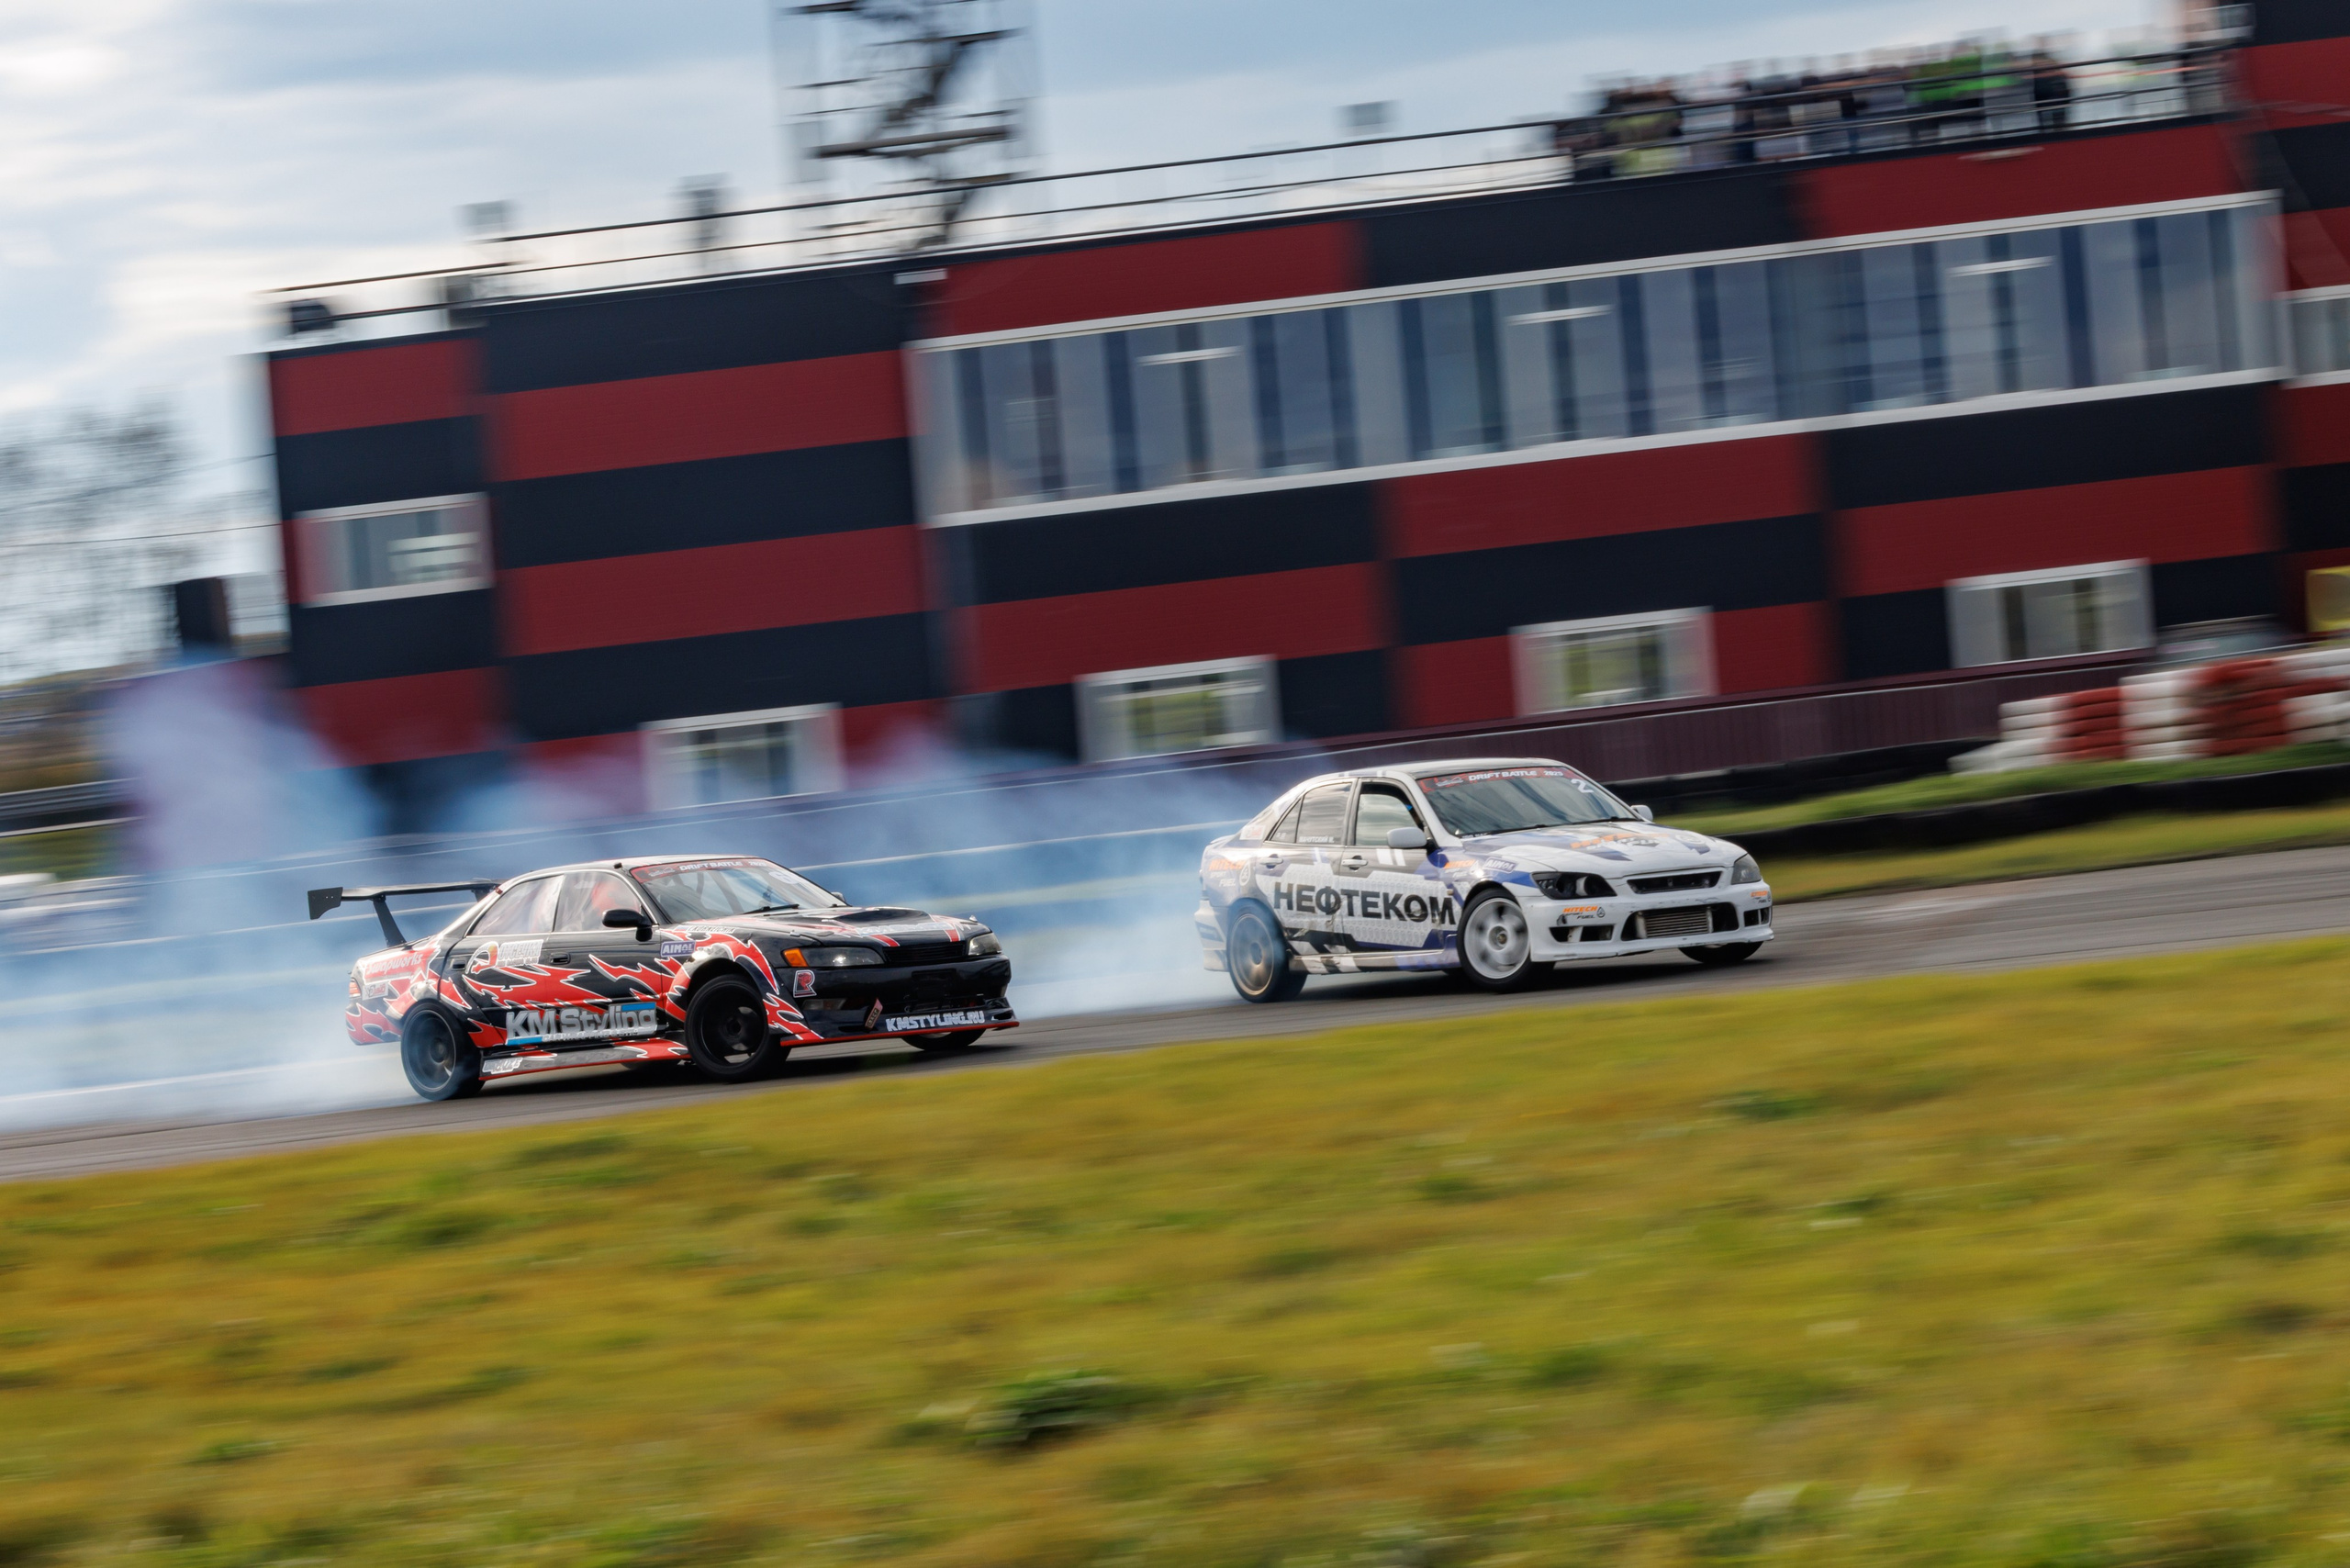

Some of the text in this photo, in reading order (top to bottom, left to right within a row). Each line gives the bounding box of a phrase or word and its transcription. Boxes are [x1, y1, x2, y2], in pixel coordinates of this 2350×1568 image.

[1469, 771, 1500, 781] DRIFT
[1571, 778, 1595, 794] 2
[679, 863, 710, 871] DRIFT
[1274, 881, 1456, 925] НЕФТЕКОМ
[1562, 905, 1598, 913] HITECH
[367, 952, 424, 974] Swapworks
[506, 1009, 556, 1039] KM
[559, 1002, 657, 1036] Styling
[885, 1011, 985, 1031] KMSTYLING.RU
